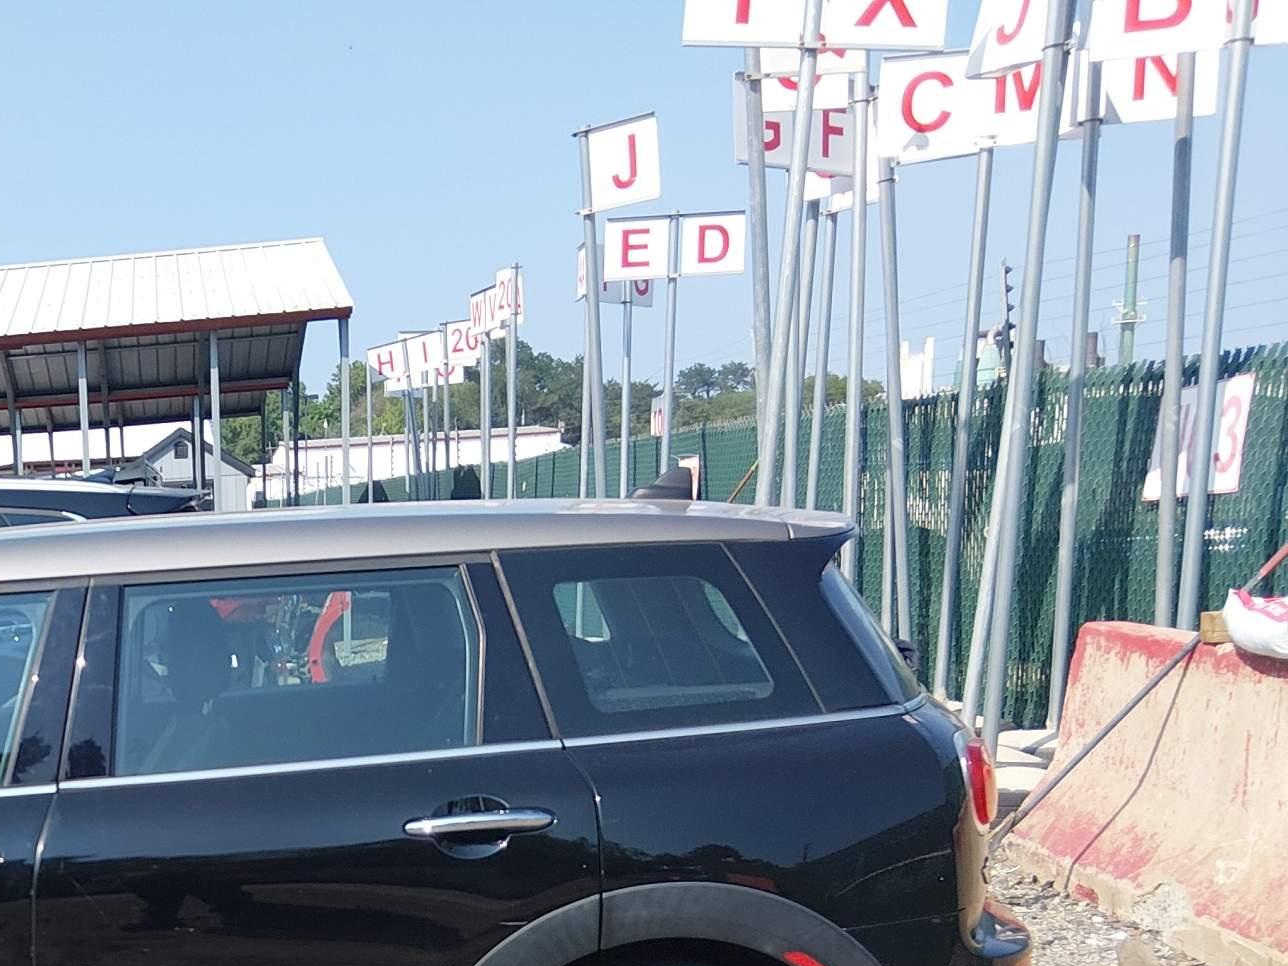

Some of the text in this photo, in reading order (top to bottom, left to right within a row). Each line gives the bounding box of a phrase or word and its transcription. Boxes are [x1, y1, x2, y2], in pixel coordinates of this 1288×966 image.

[902, 71, 954, 133] C
[822, 107, 847, 158] F
[612, 133, 638, 189] J
[621, 224, 730, 268] E D
[377, 350, 394, 375] H
